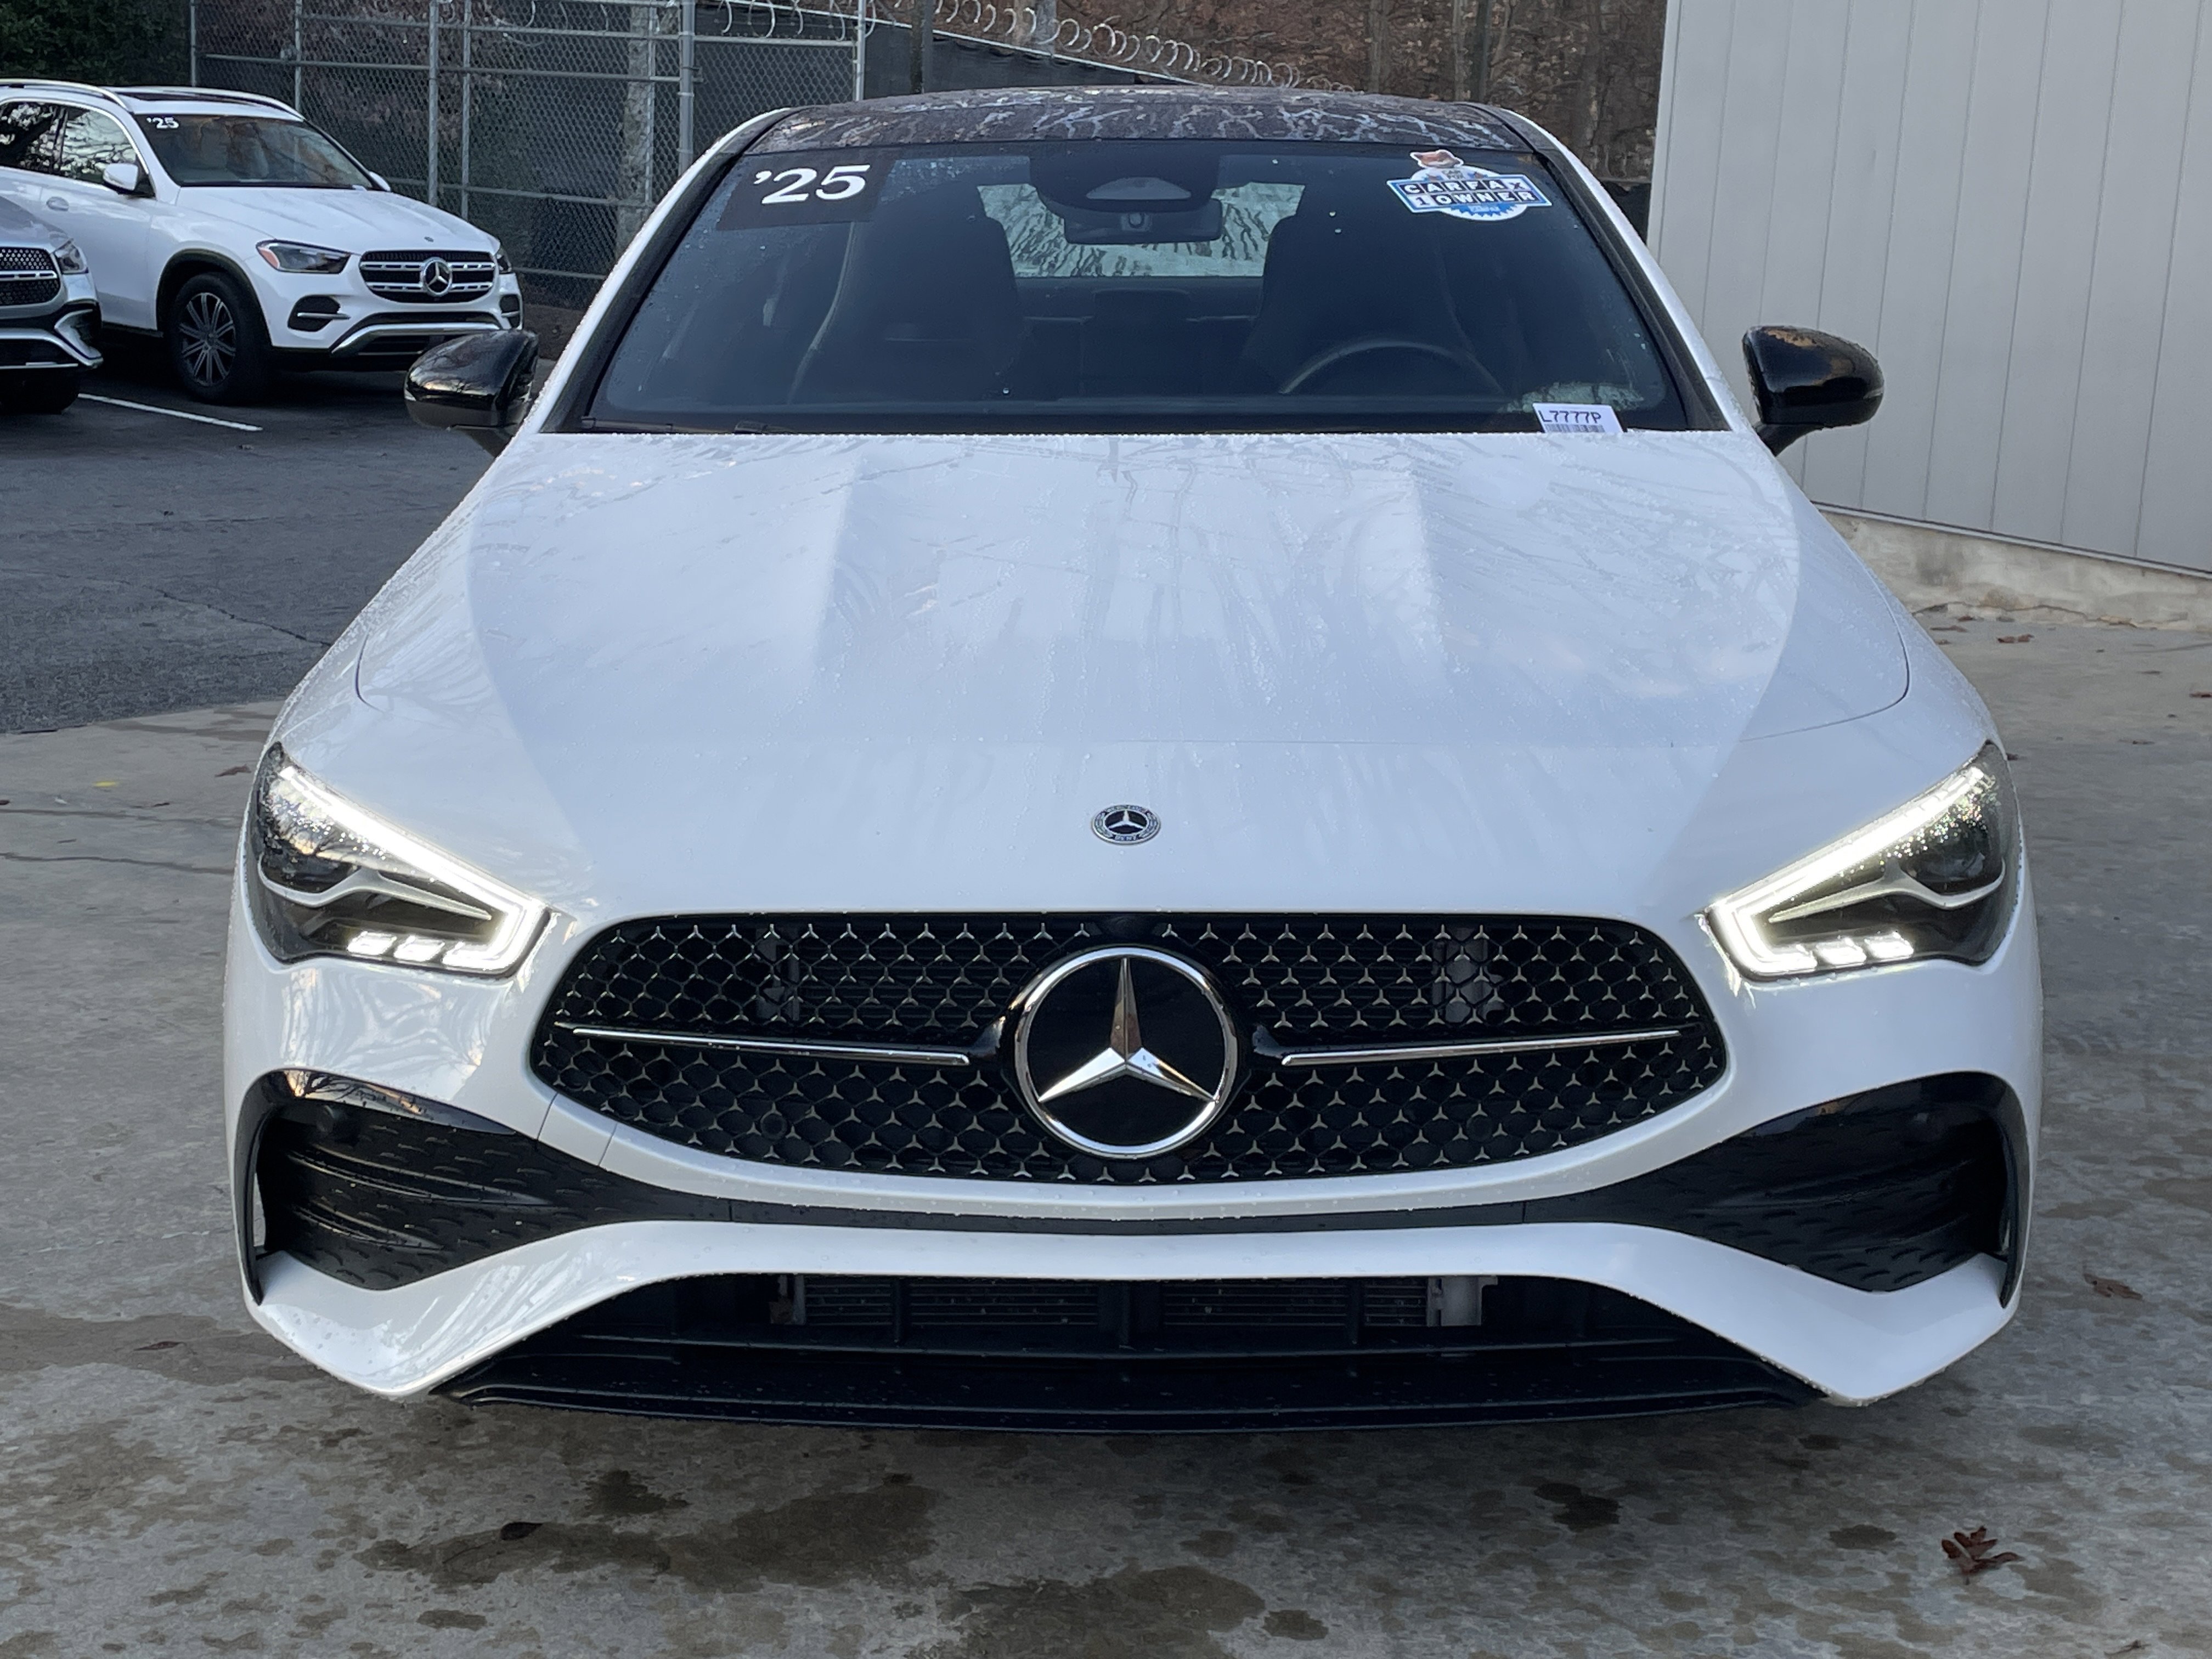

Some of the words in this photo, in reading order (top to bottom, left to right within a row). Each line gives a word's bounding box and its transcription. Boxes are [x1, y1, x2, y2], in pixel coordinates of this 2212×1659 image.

[1404, 180, 1526, 194] CARFAX
[1414, 196, 1430, 206] 1
[1436, 191, 1536, 205] OWNER
[1538, 410, 1602, 424] L7777P
